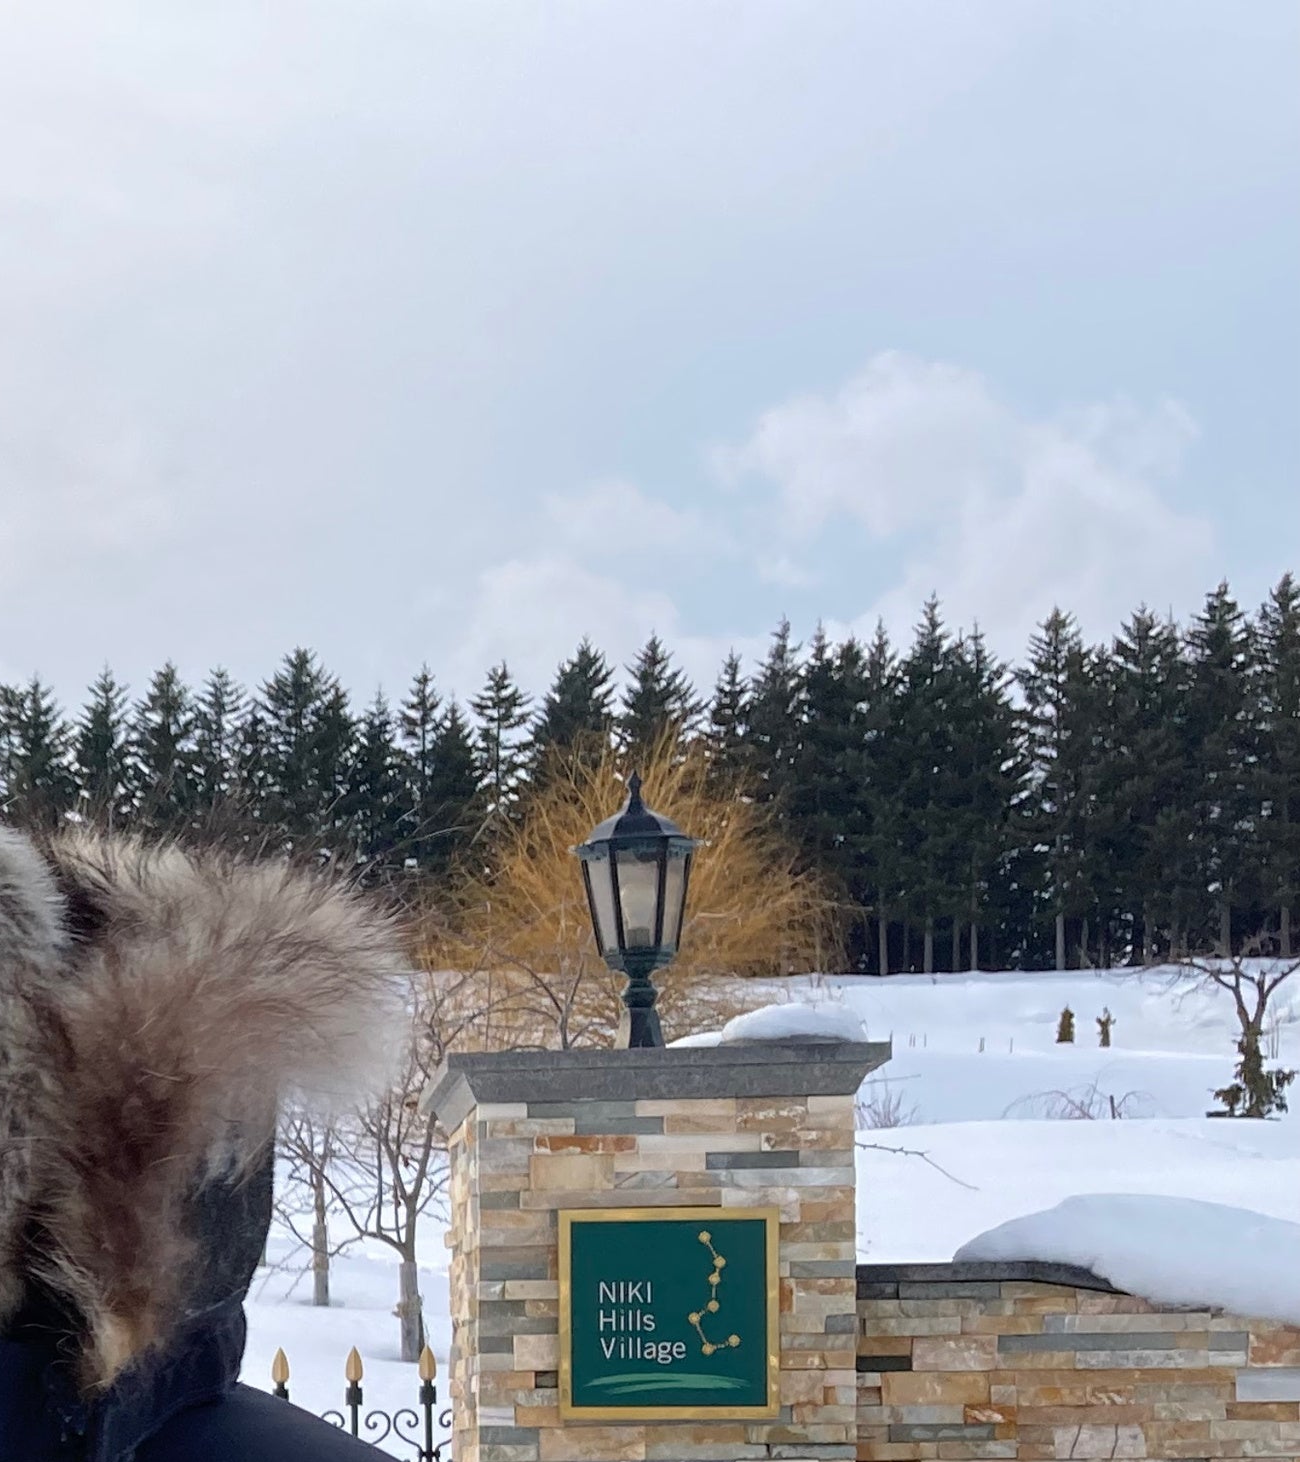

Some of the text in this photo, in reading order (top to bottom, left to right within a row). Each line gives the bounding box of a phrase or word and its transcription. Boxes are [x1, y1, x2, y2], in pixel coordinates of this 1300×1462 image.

[599, 1281, 652, 1304] NIKI
[599, 1309, 656, 1332] Hills
[600, 1336, 687, 1365] Village
